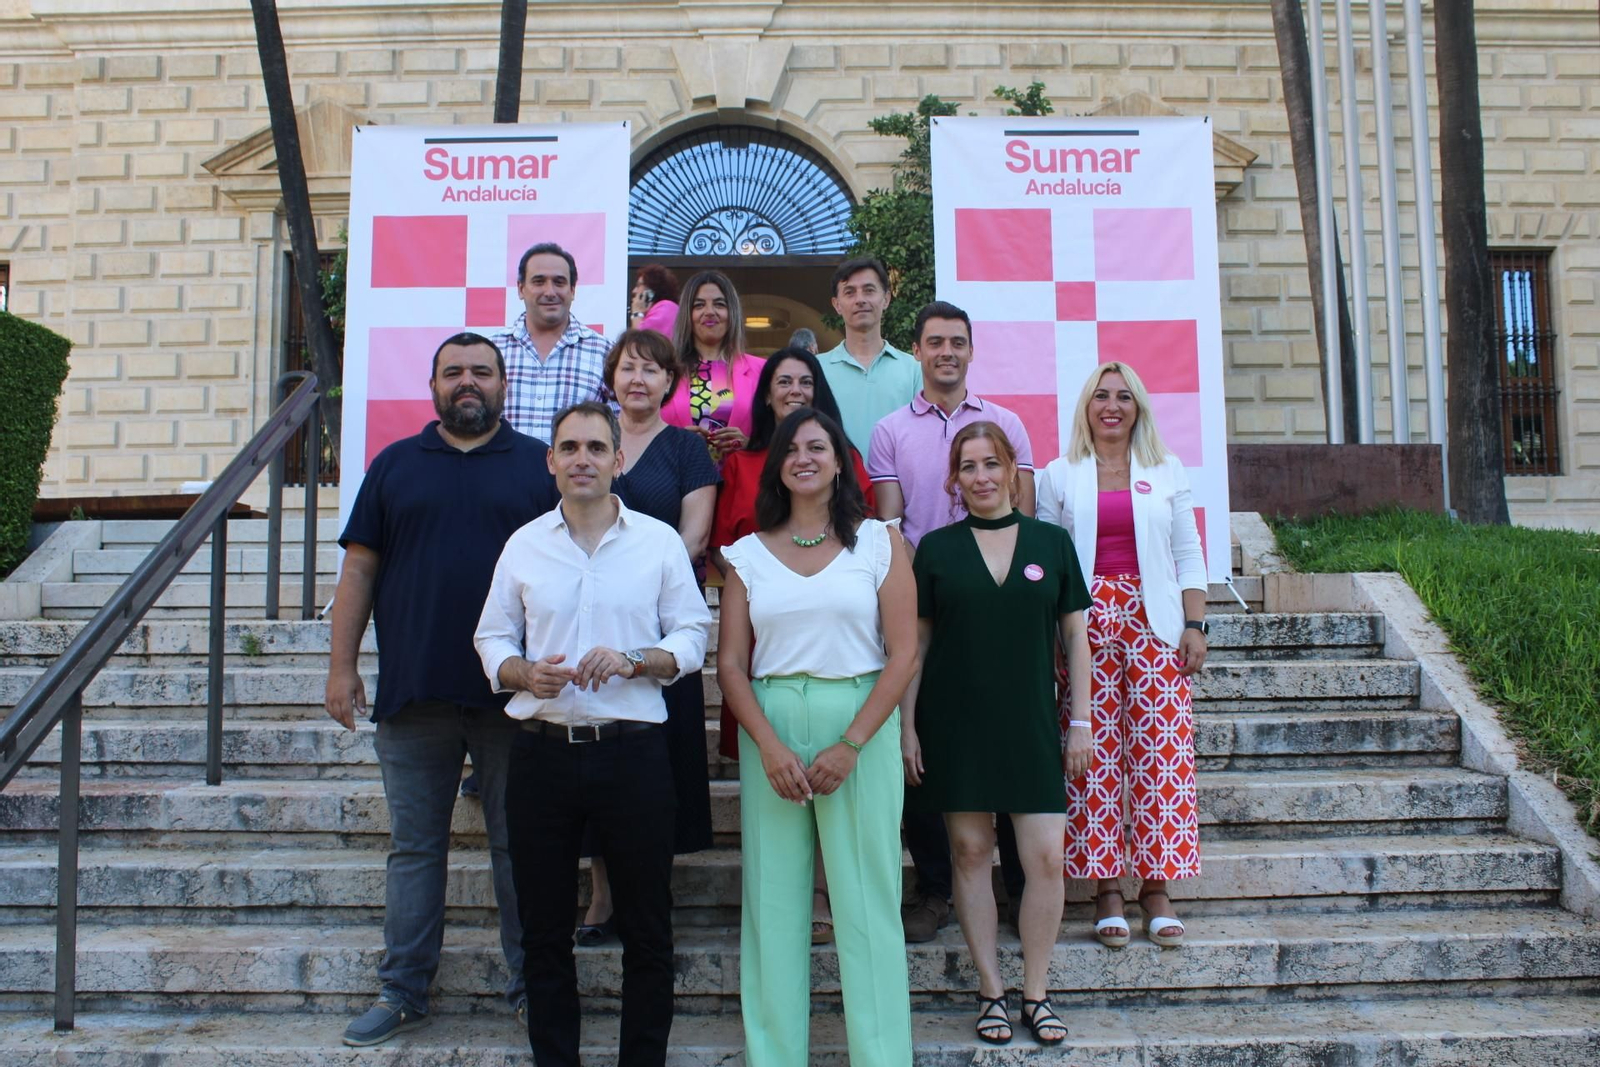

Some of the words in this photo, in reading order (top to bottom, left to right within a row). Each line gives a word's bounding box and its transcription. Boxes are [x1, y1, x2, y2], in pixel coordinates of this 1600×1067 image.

[424, 148, 557, 180] Sumar
[1006, 140, 1140, 173] Sumar
[441, 185, 537, 202] Andalucía
[1026, 178, 1121, 195] Andalucía
